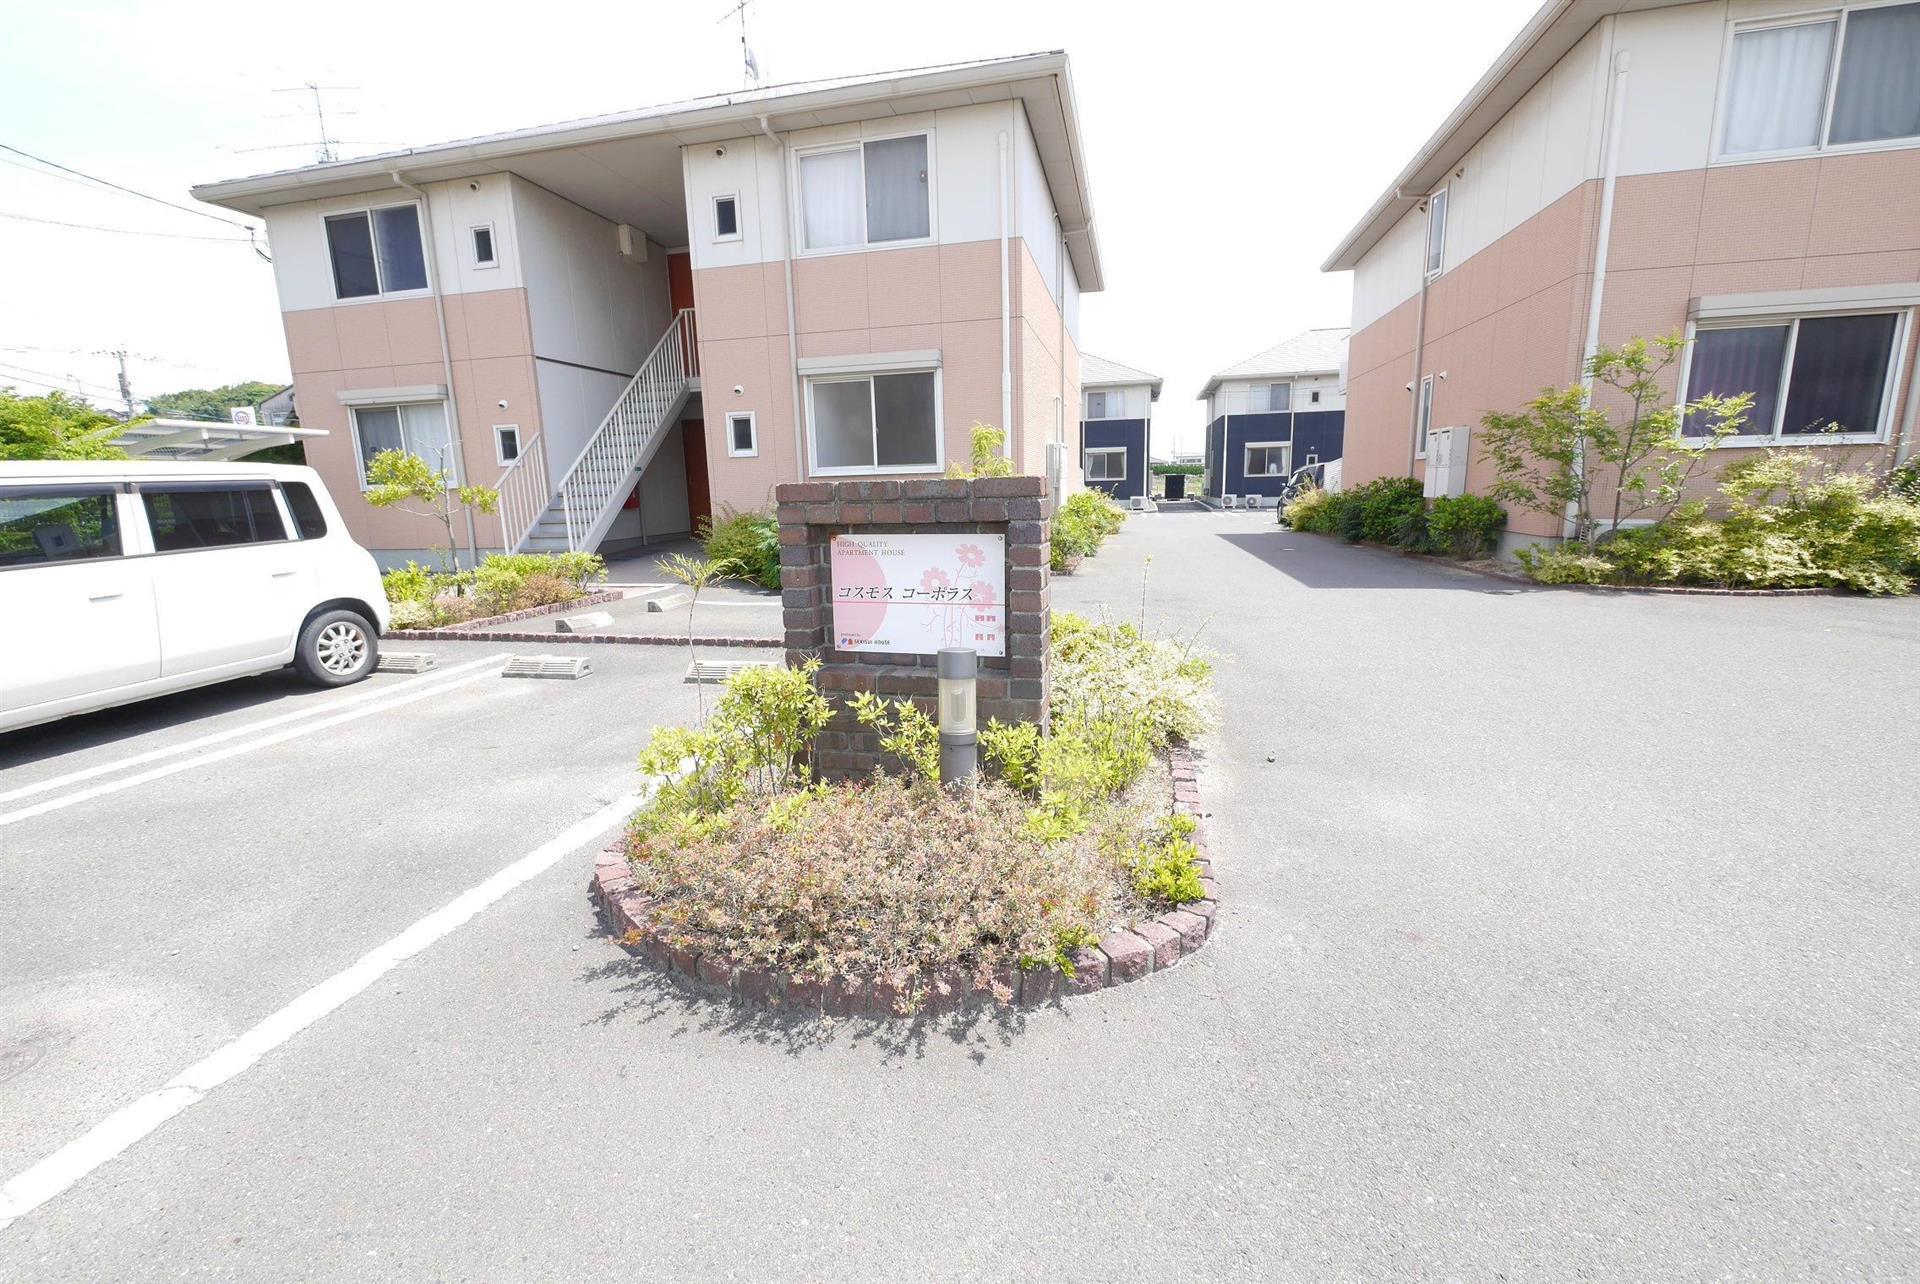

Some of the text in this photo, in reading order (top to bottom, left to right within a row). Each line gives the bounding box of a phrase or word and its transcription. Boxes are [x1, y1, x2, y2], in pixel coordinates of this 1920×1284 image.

[858, 541, 888, 549] QUALITY
[838, 586, 973, 602] コスモス コーポラス
